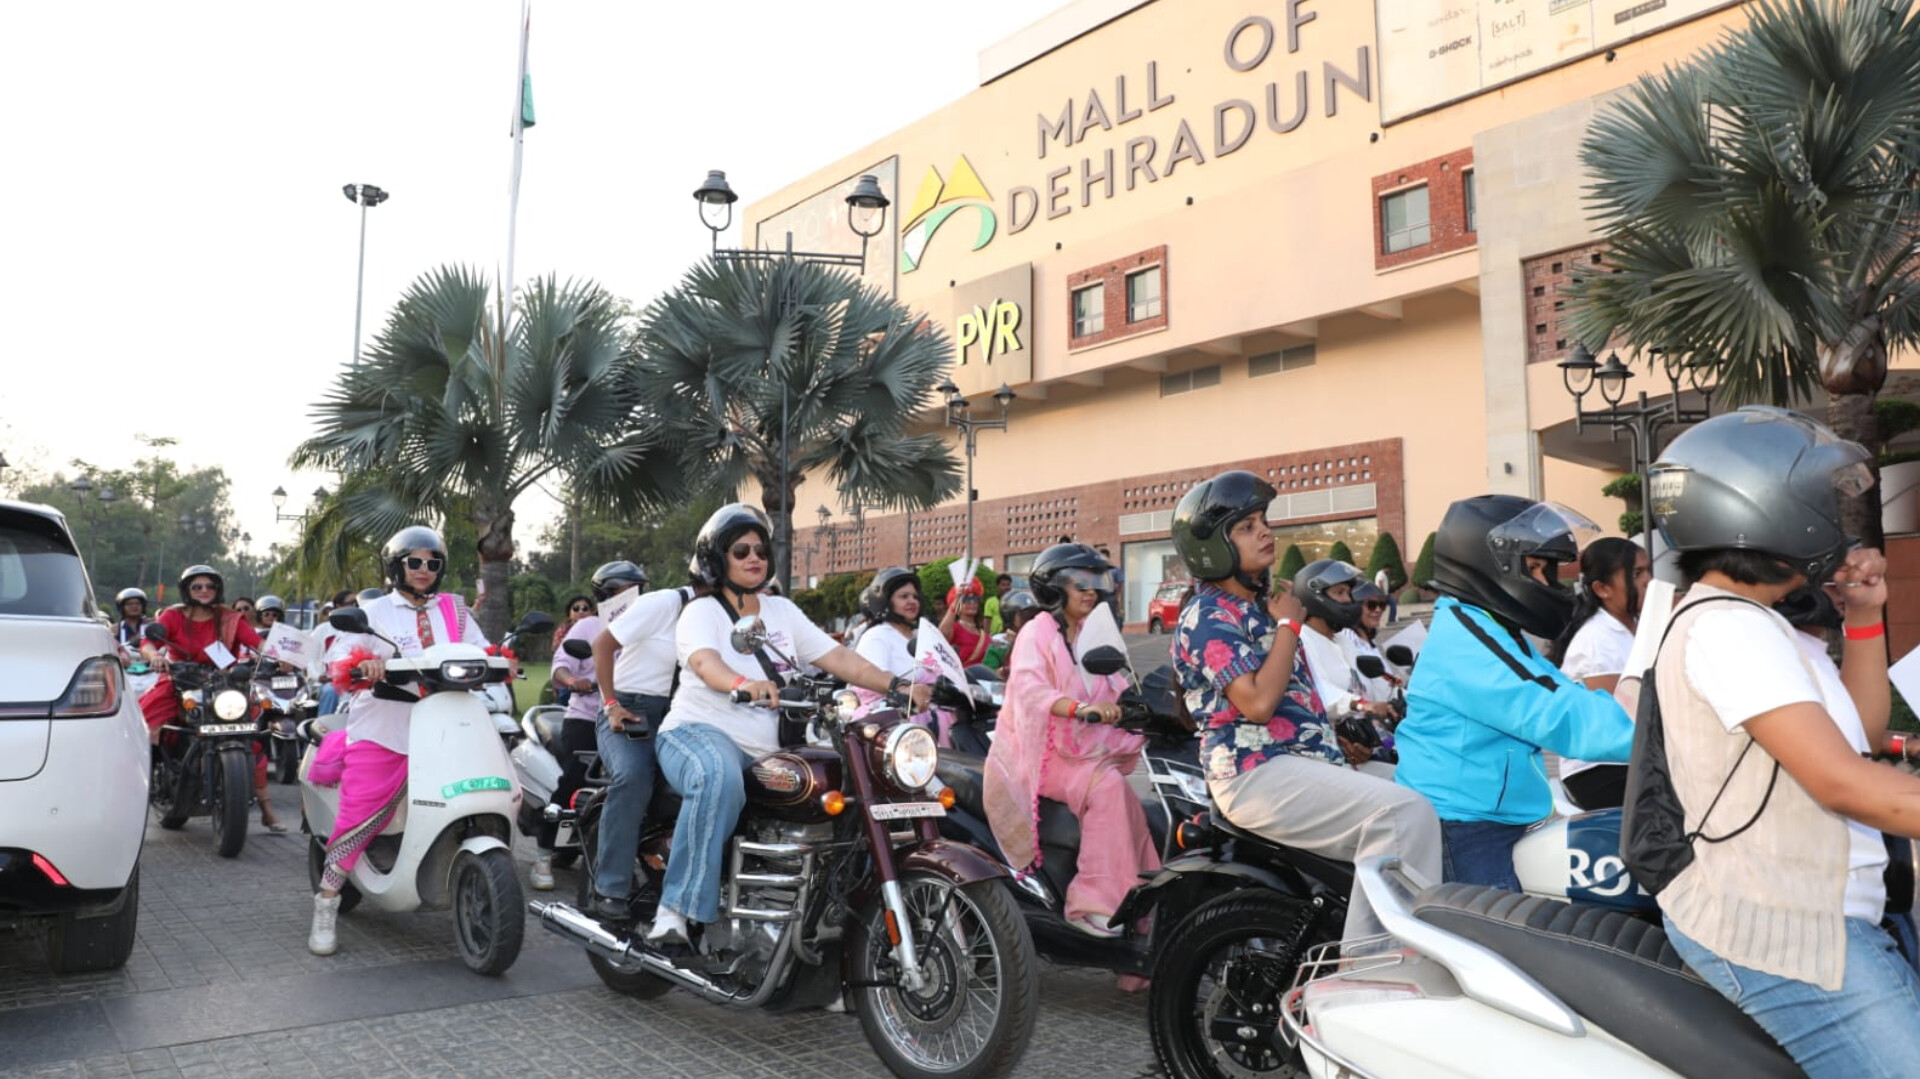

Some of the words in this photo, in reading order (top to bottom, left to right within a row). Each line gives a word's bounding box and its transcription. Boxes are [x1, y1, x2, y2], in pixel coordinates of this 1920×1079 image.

[1037, 60, 1175, 159] MALL
[1224, 0, 1317, 72] OF
[1007, 45, 1371, 235] DEHRADUN
[956, 298, 1024, 367] PVR
[1565, 848, 1651, 896] RO
